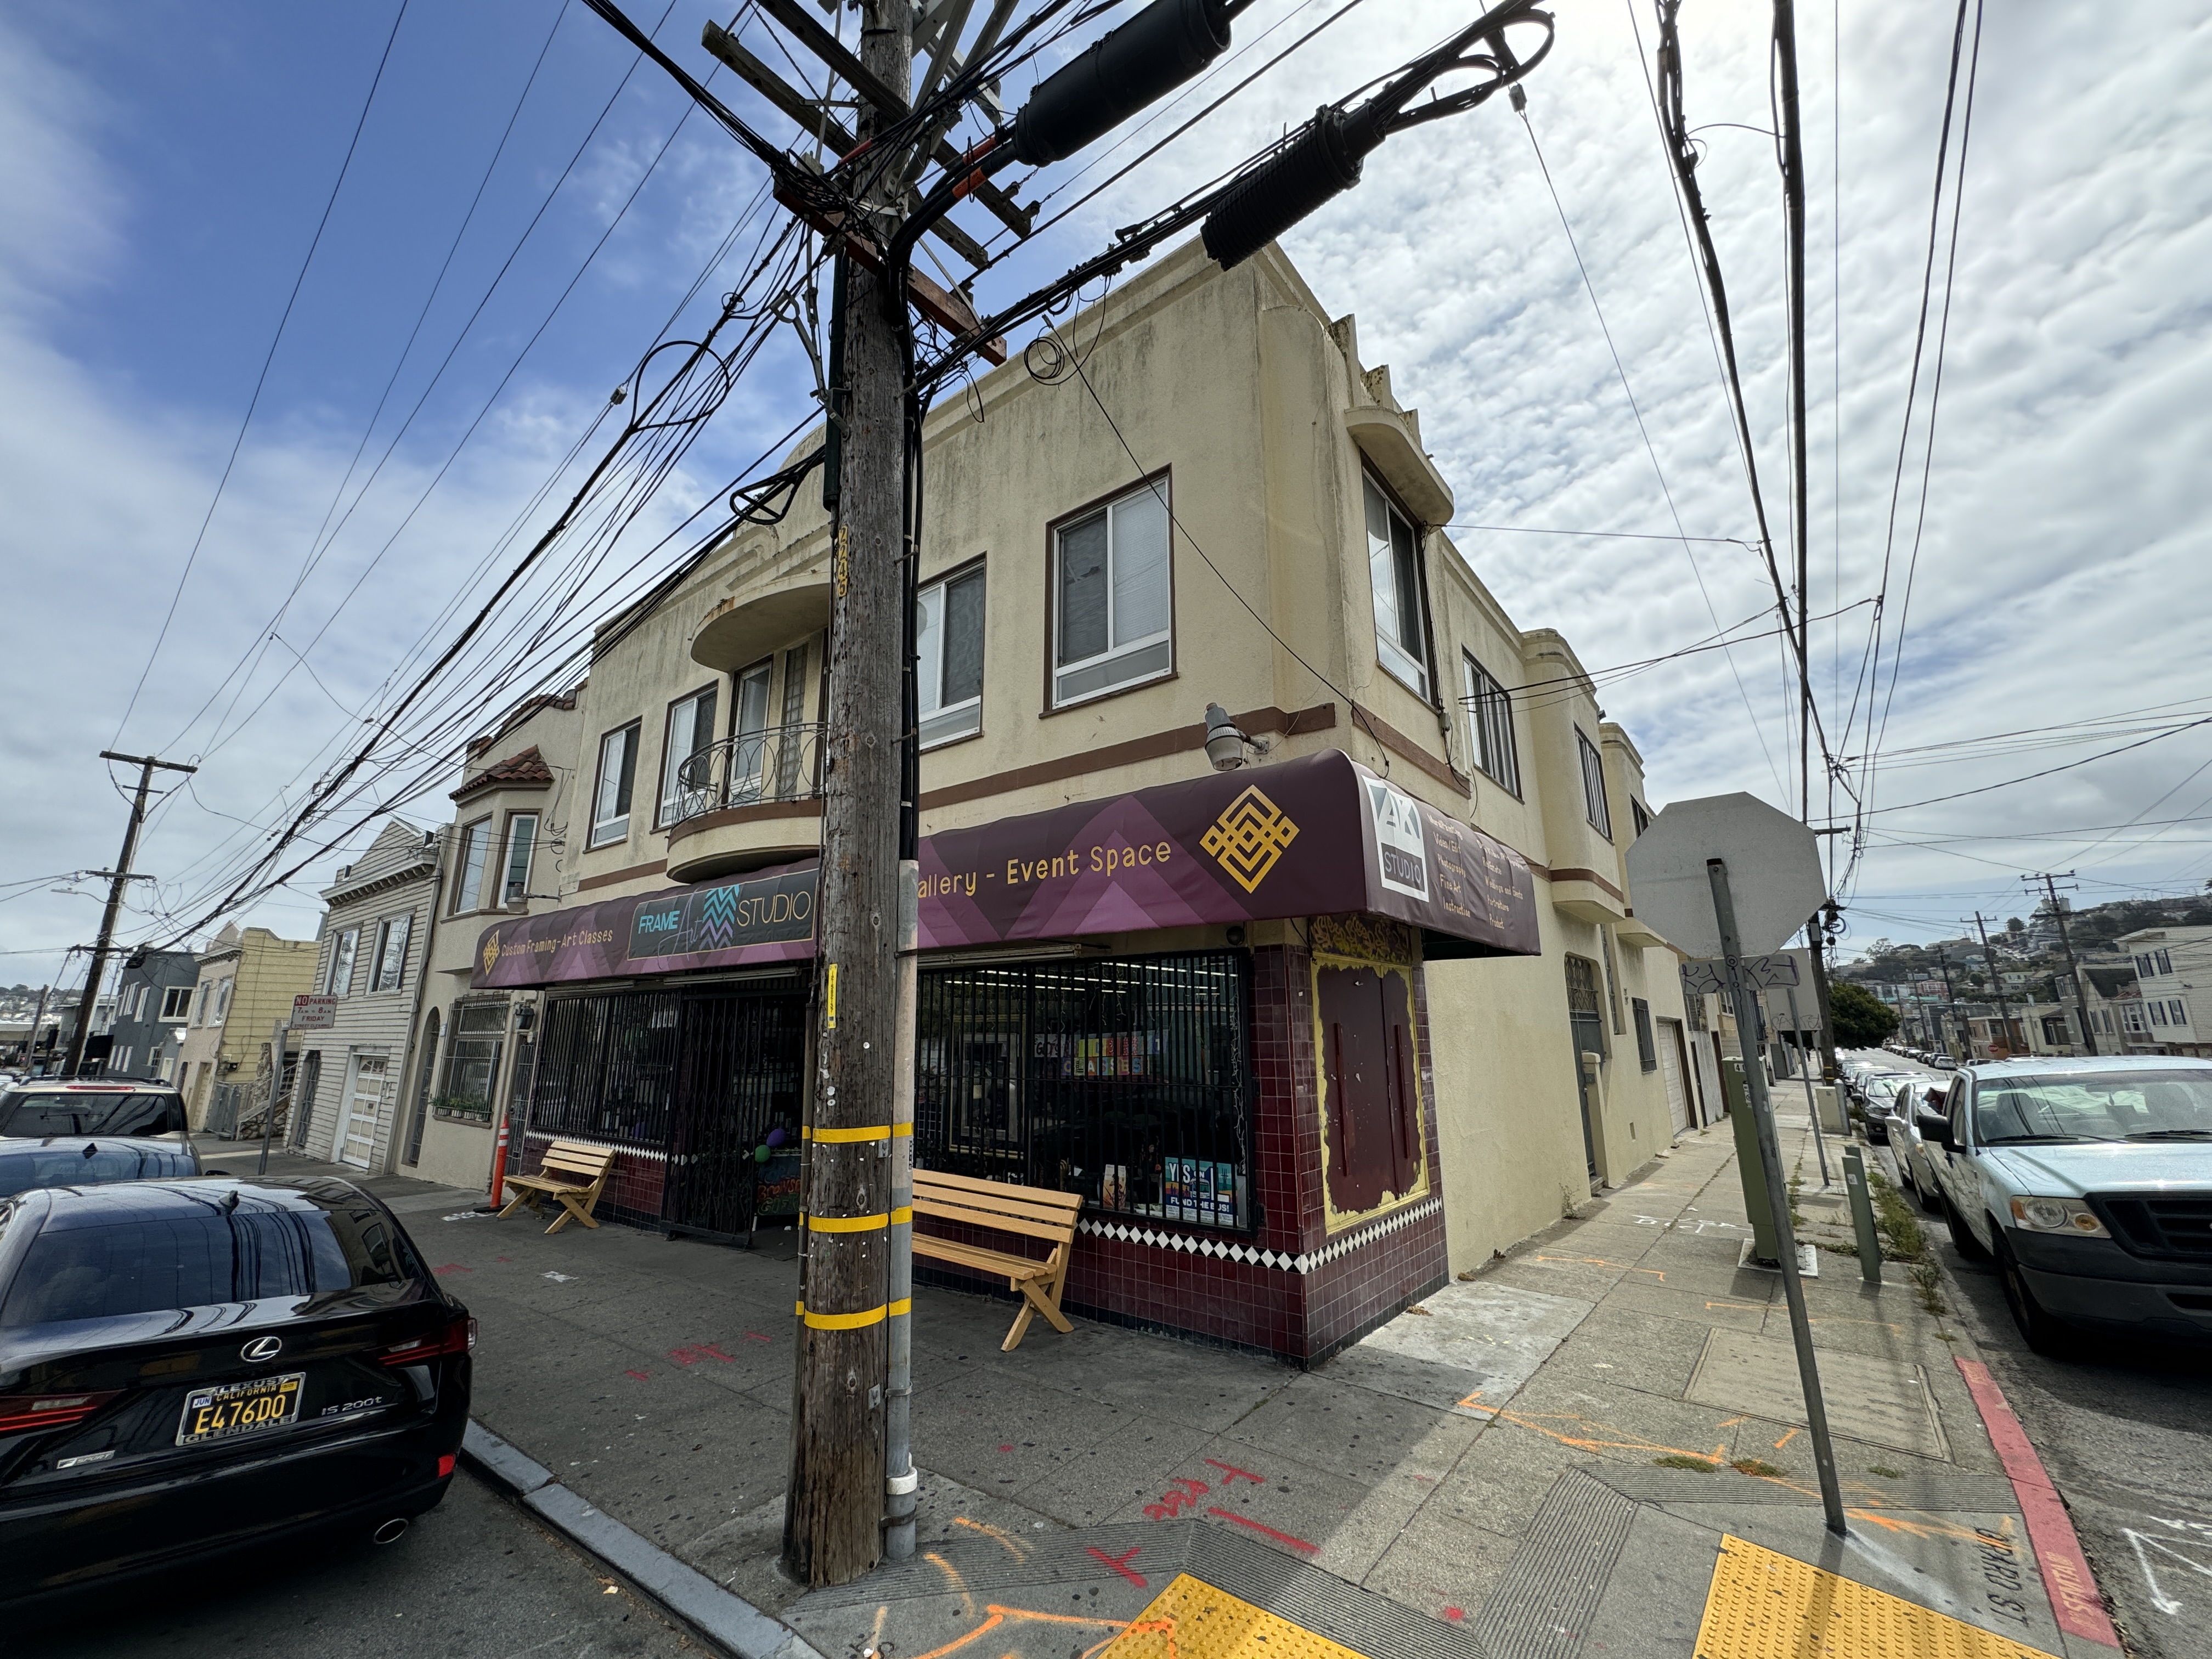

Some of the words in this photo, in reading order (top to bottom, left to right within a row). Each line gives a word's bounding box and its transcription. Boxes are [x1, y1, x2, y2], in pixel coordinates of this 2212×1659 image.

[918, 872, 977, 897] allery
[1007, 849, 1080, 884] Event
[1090, 841, 1171, 877] Space
[1384, 851, 1421, 884] STUDIO
[1437, 853, 1466, 878] Photography
[1440, 873, 1453, 890] Fine
[1453, 881, 1462, 894] Art
[638, 910, 681, 934] FRAME
[737, 891, 811, 927] STUDIO
[1443, 896, 1471, 918] Instruction
[501, 944, 526, 957] Custom
[579, 930, 613, 945] Classes
[296, 996, 308, 1005] NO
[216, 1384, 276, 1402] CALIFORNIA
[218, 1378, 278, 1394] LEXUS
[194, 1397, 211, 1407] JUN
[321, 1404, 339, 1416] IS
[342, 1396, 382, 1412] 200t
[185, 1415, 292, 1443] GLENDALE
[1987, 1593, 2029, 1628] ST
